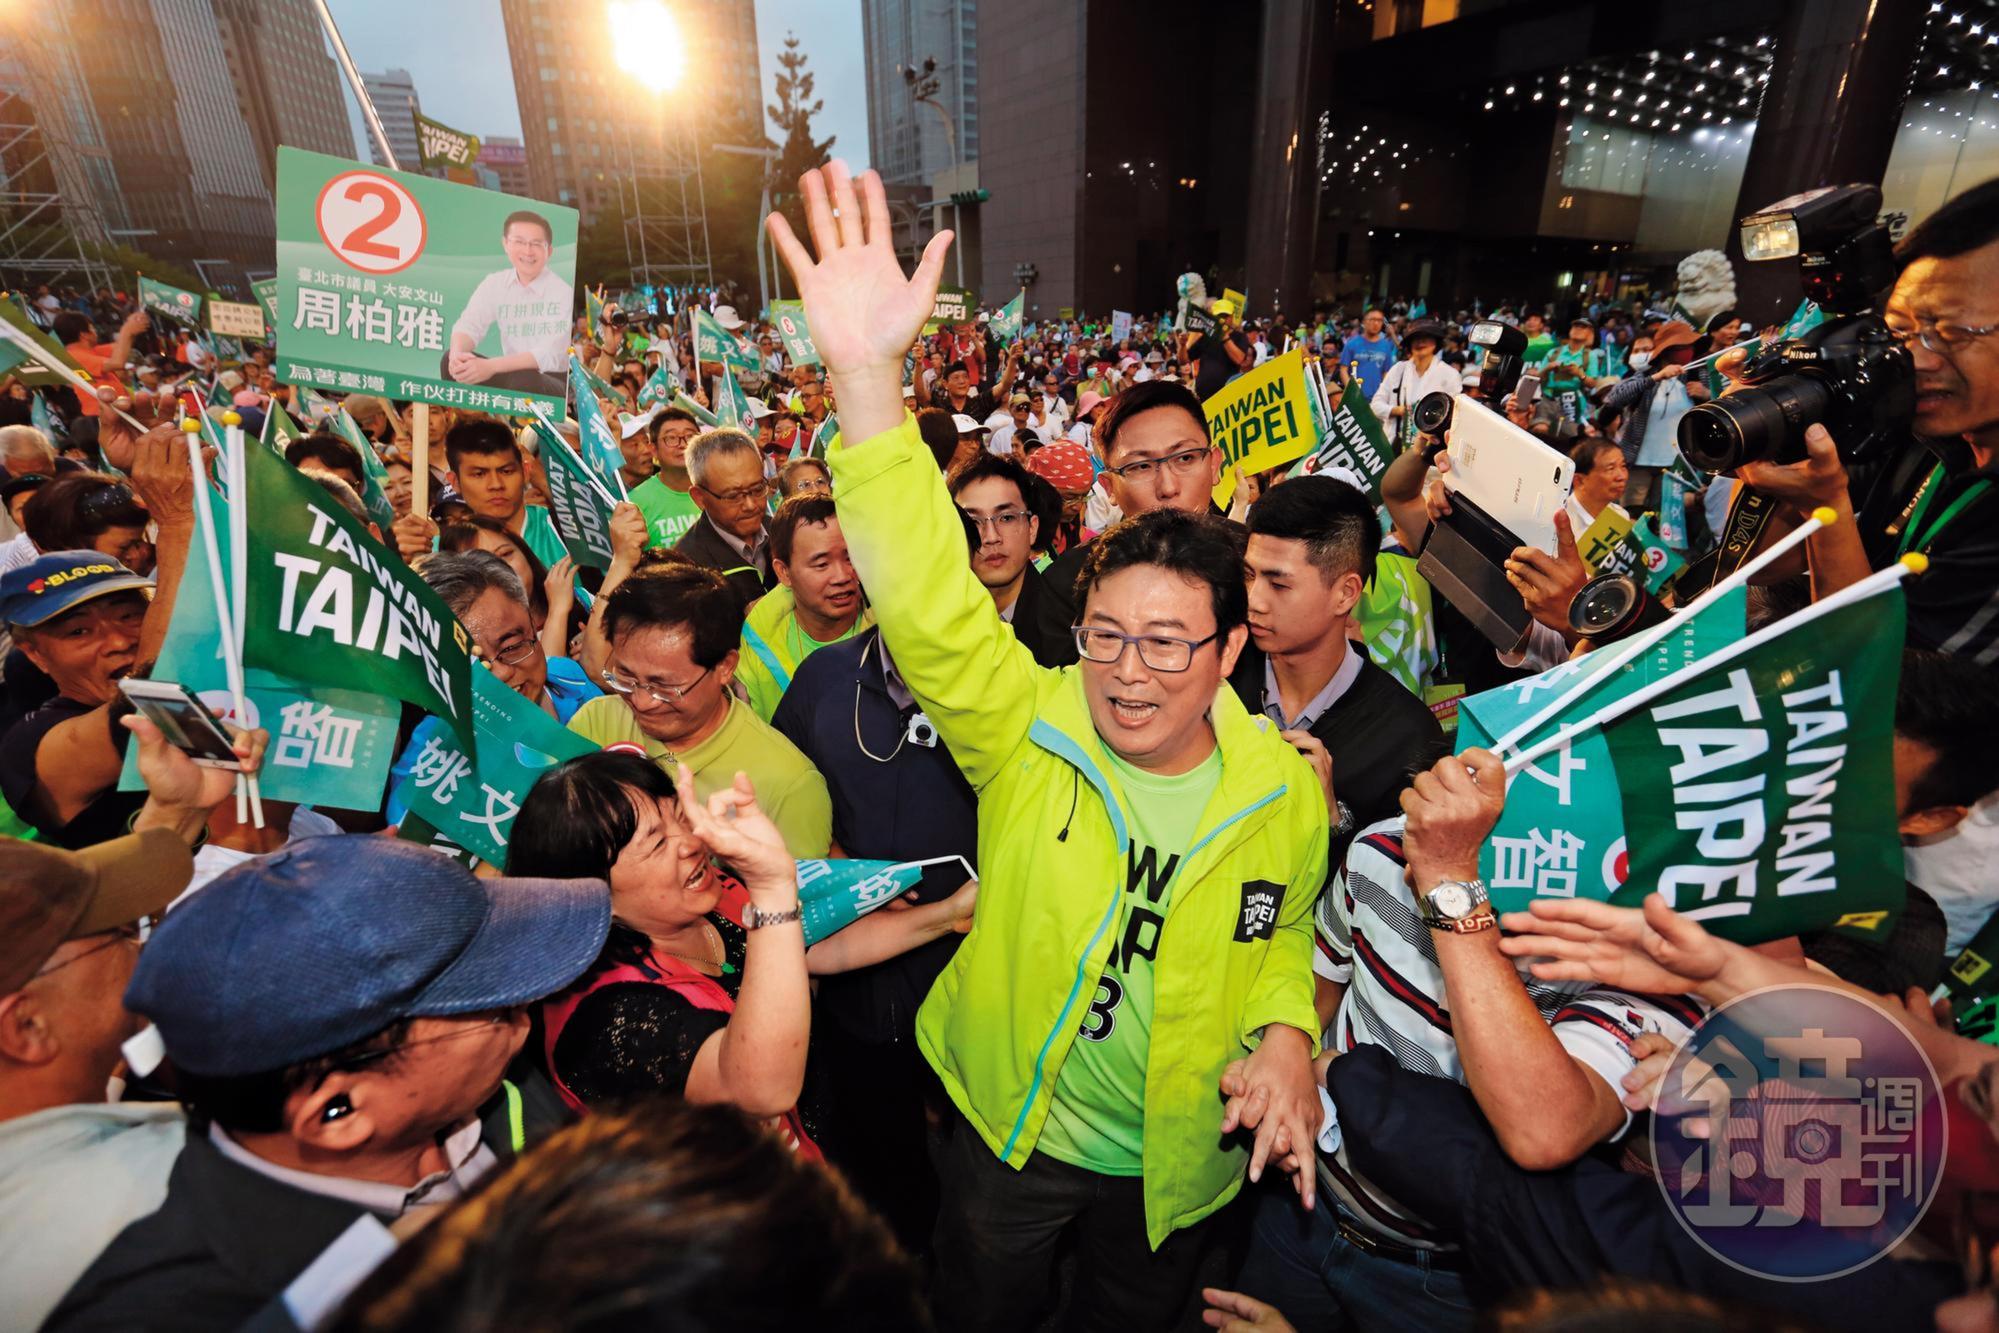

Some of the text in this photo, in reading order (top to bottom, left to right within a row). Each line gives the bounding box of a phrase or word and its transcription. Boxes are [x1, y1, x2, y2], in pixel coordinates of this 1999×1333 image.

[341, 181, 402, 261] 2
[293, 287, 444, 351] 周柏雅
[297, 266, 443, 305] 臺北市議員 大安文山
[1789, 350, 1818, 360] Nikon
[1333, 404, 1386, 477] TAIWAN
[307, 503, 441, 650] TAIWAN
[274, 551, 458, 720] TAIPEI
[1650, 668, 1769, 921] TAIPEI
[1777, 670, 1849, 897] TAIWAN
